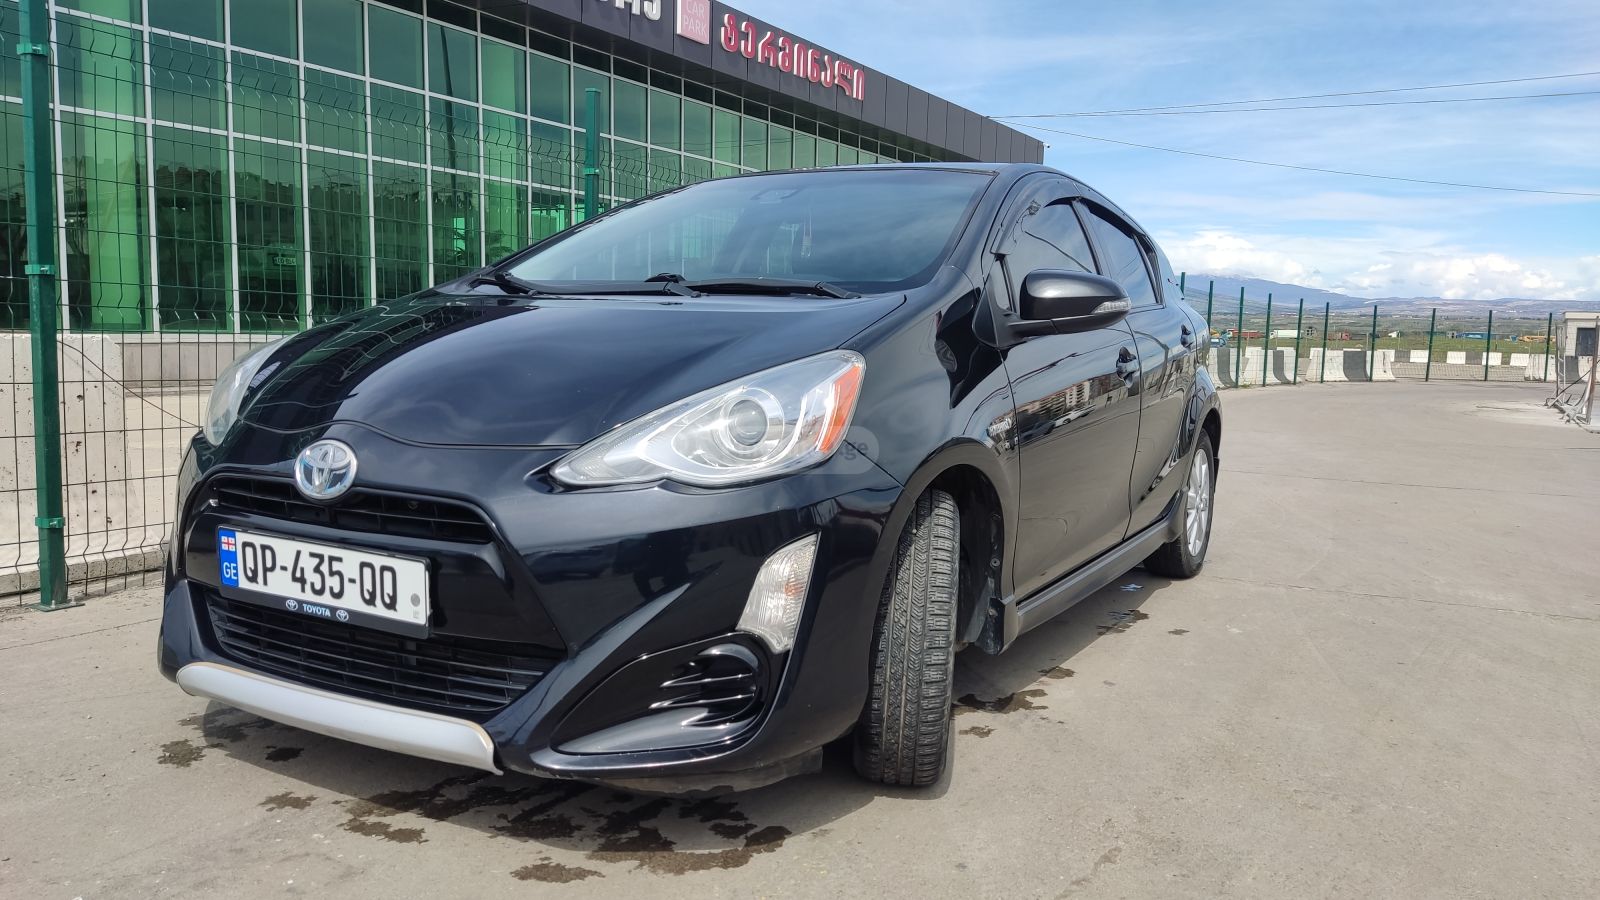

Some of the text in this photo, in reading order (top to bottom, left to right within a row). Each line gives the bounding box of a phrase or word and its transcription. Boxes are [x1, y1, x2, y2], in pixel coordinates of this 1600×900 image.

[685, 0, 705, 17] CAR
[683, 16, 708, 36] PARK
[720, 13, 865, 101] ტერმინალი
[223, 562, 238, 580] GE
[241, 541, 398, 612] QP-435-QQ
[302, 603, 331, 617] TOYOTA
